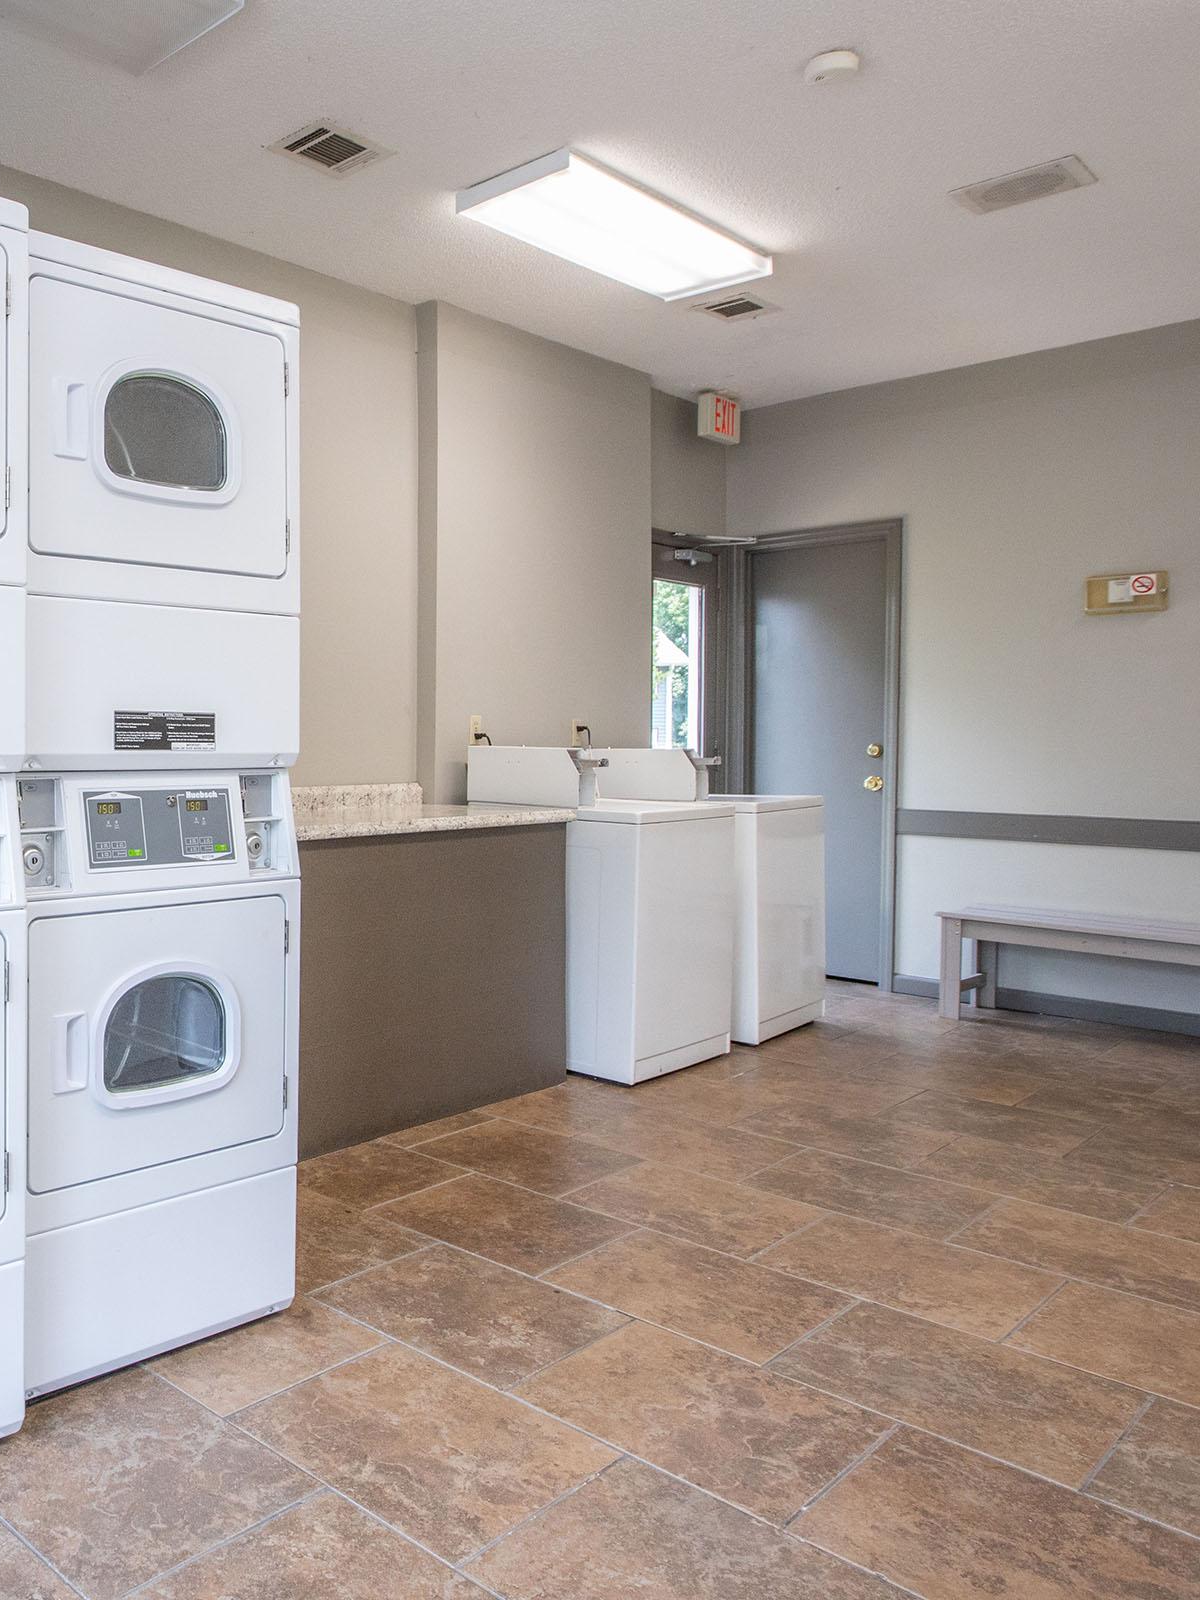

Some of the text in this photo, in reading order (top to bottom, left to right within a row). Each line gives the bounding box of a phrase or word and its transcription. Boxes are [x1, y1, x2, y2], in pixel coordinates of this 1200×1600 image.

[714, 397, 736, 436] EXIT
[185, 790, 218, 798] Huebsch
[98, 804, 114, 813] 150
[187, 802, 201, 811] 150
